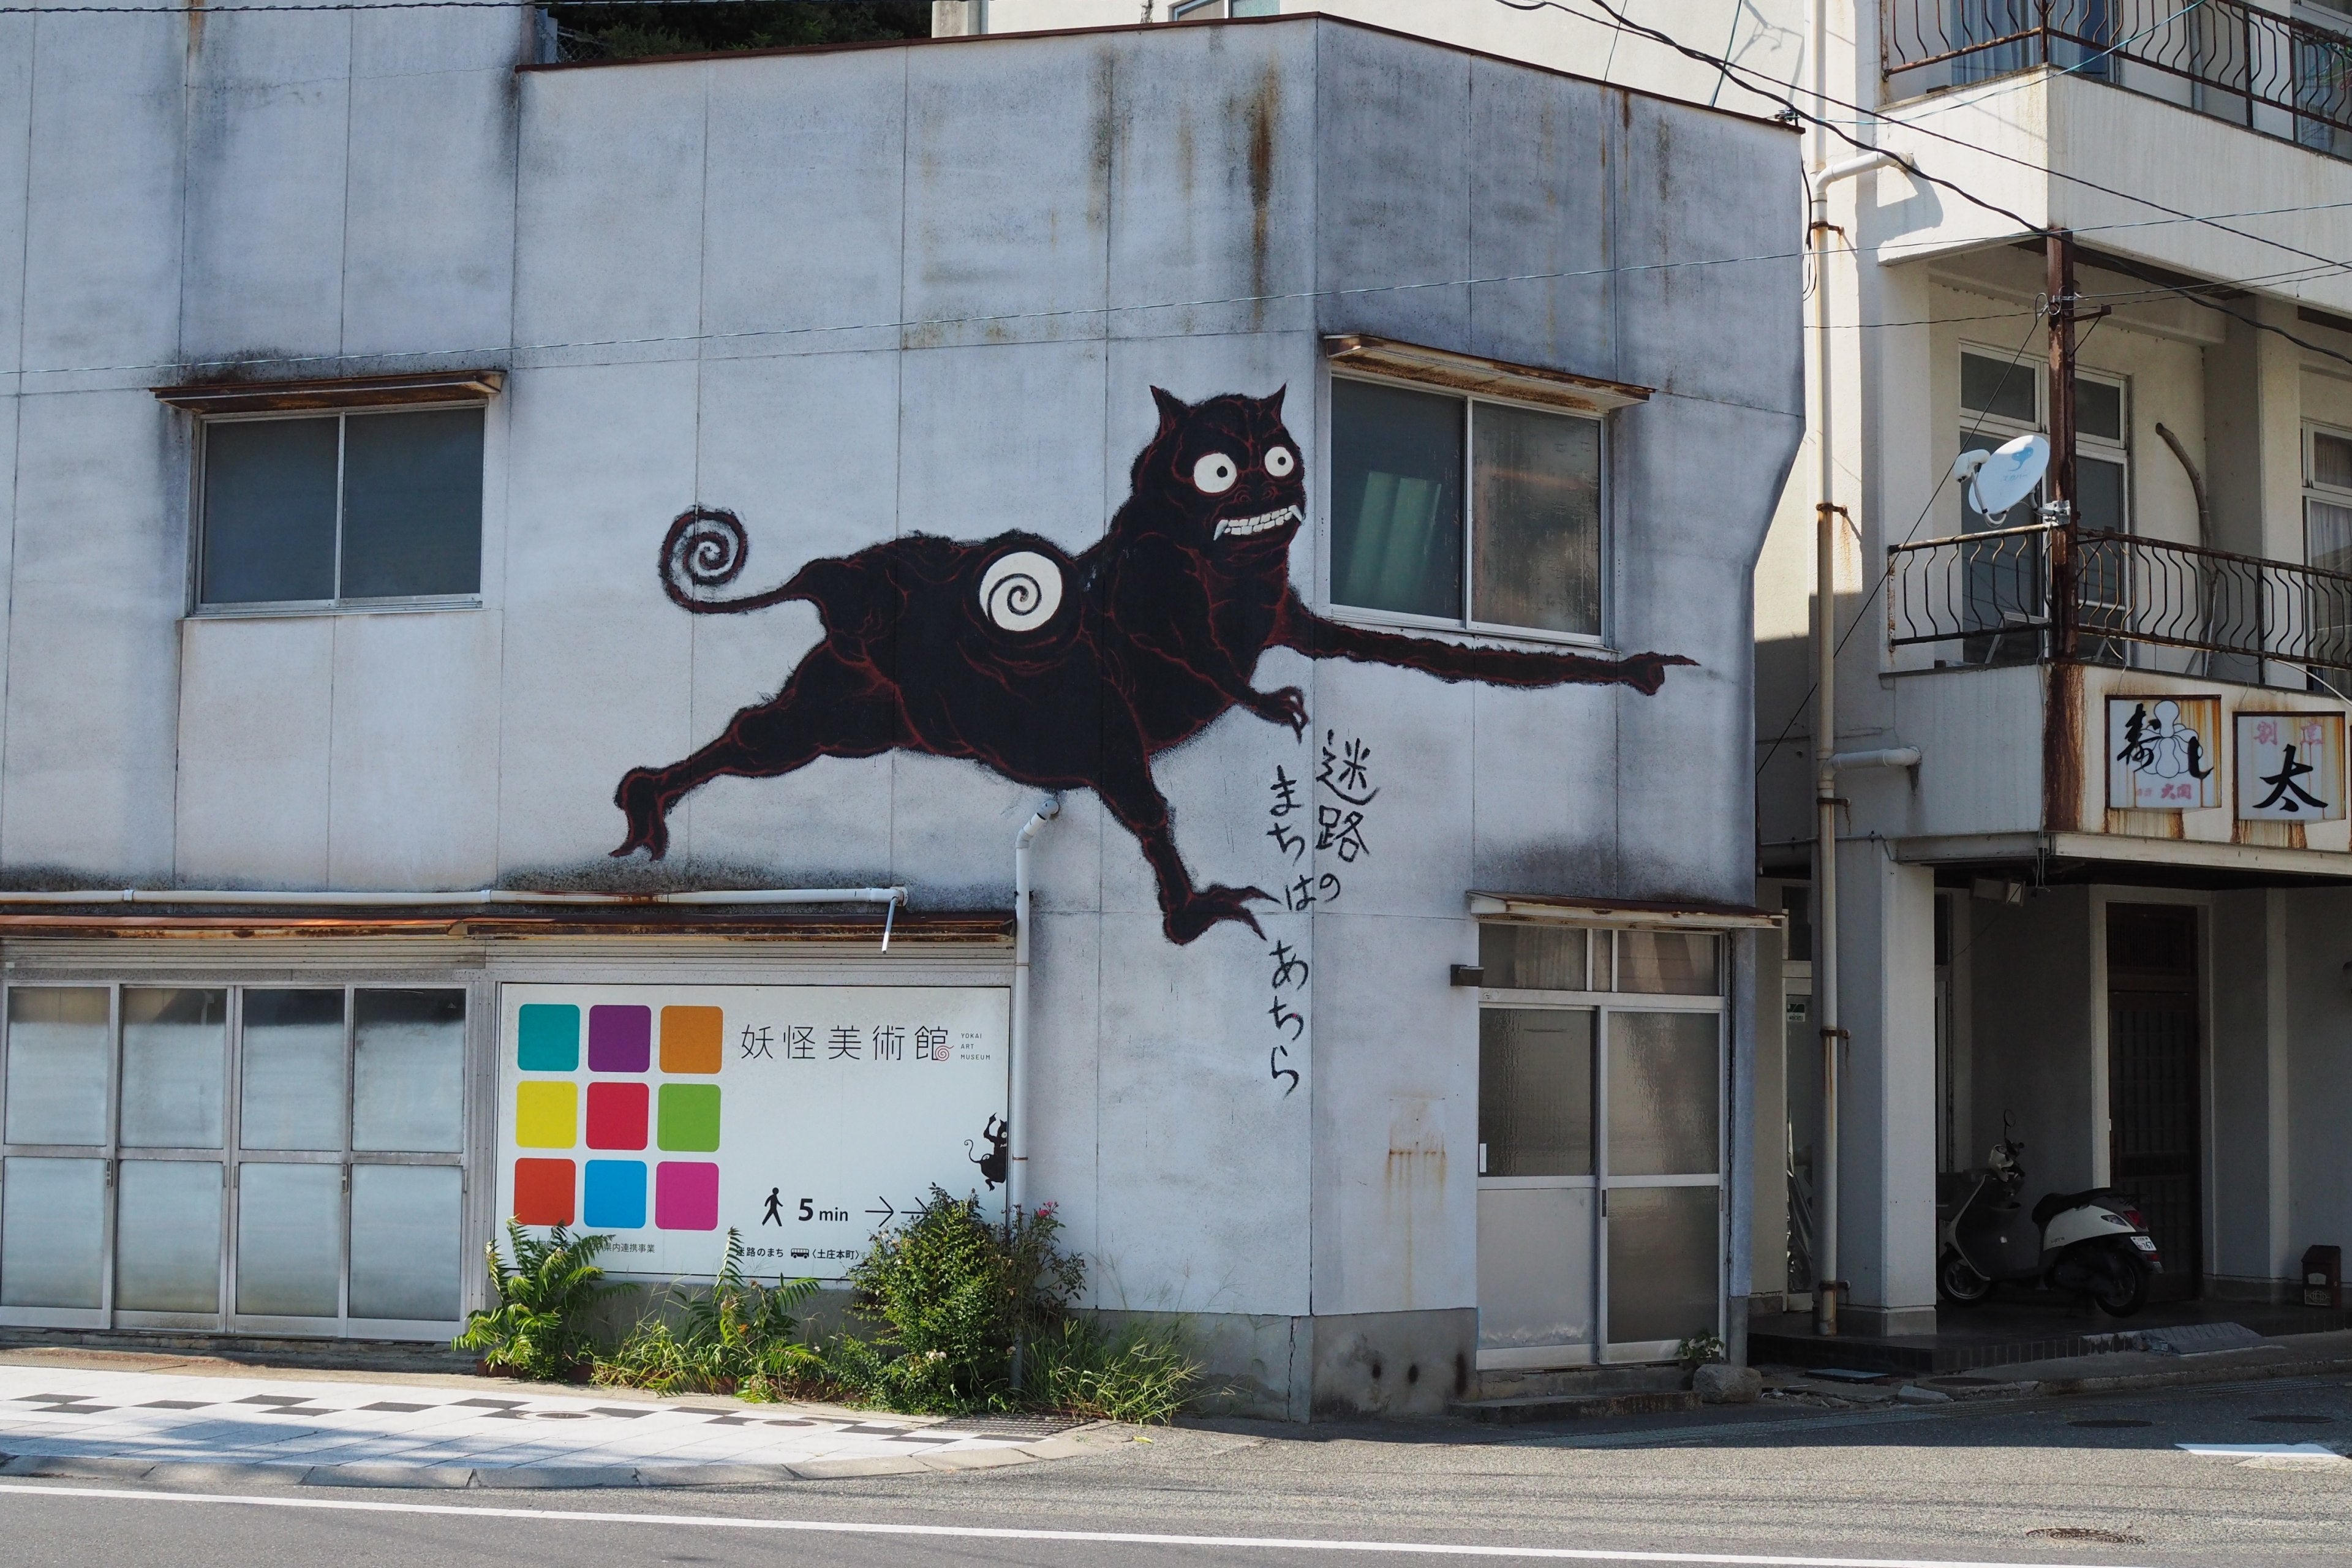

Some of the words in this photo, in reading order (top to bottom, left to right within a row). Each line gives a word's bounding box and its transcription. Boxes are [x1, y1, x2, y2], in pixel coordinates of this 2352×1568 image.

[2252, 744, 2328, 812] 太
[1315, 729, 1380, 903] 迷路の
[741, 1024, 949, 1061] 妖怪美術館
[798, 1198, 813, 1221] 5
[820, 1207, 848, 1221] min
[736, 1247, 784, 1257] 迷路のまち
